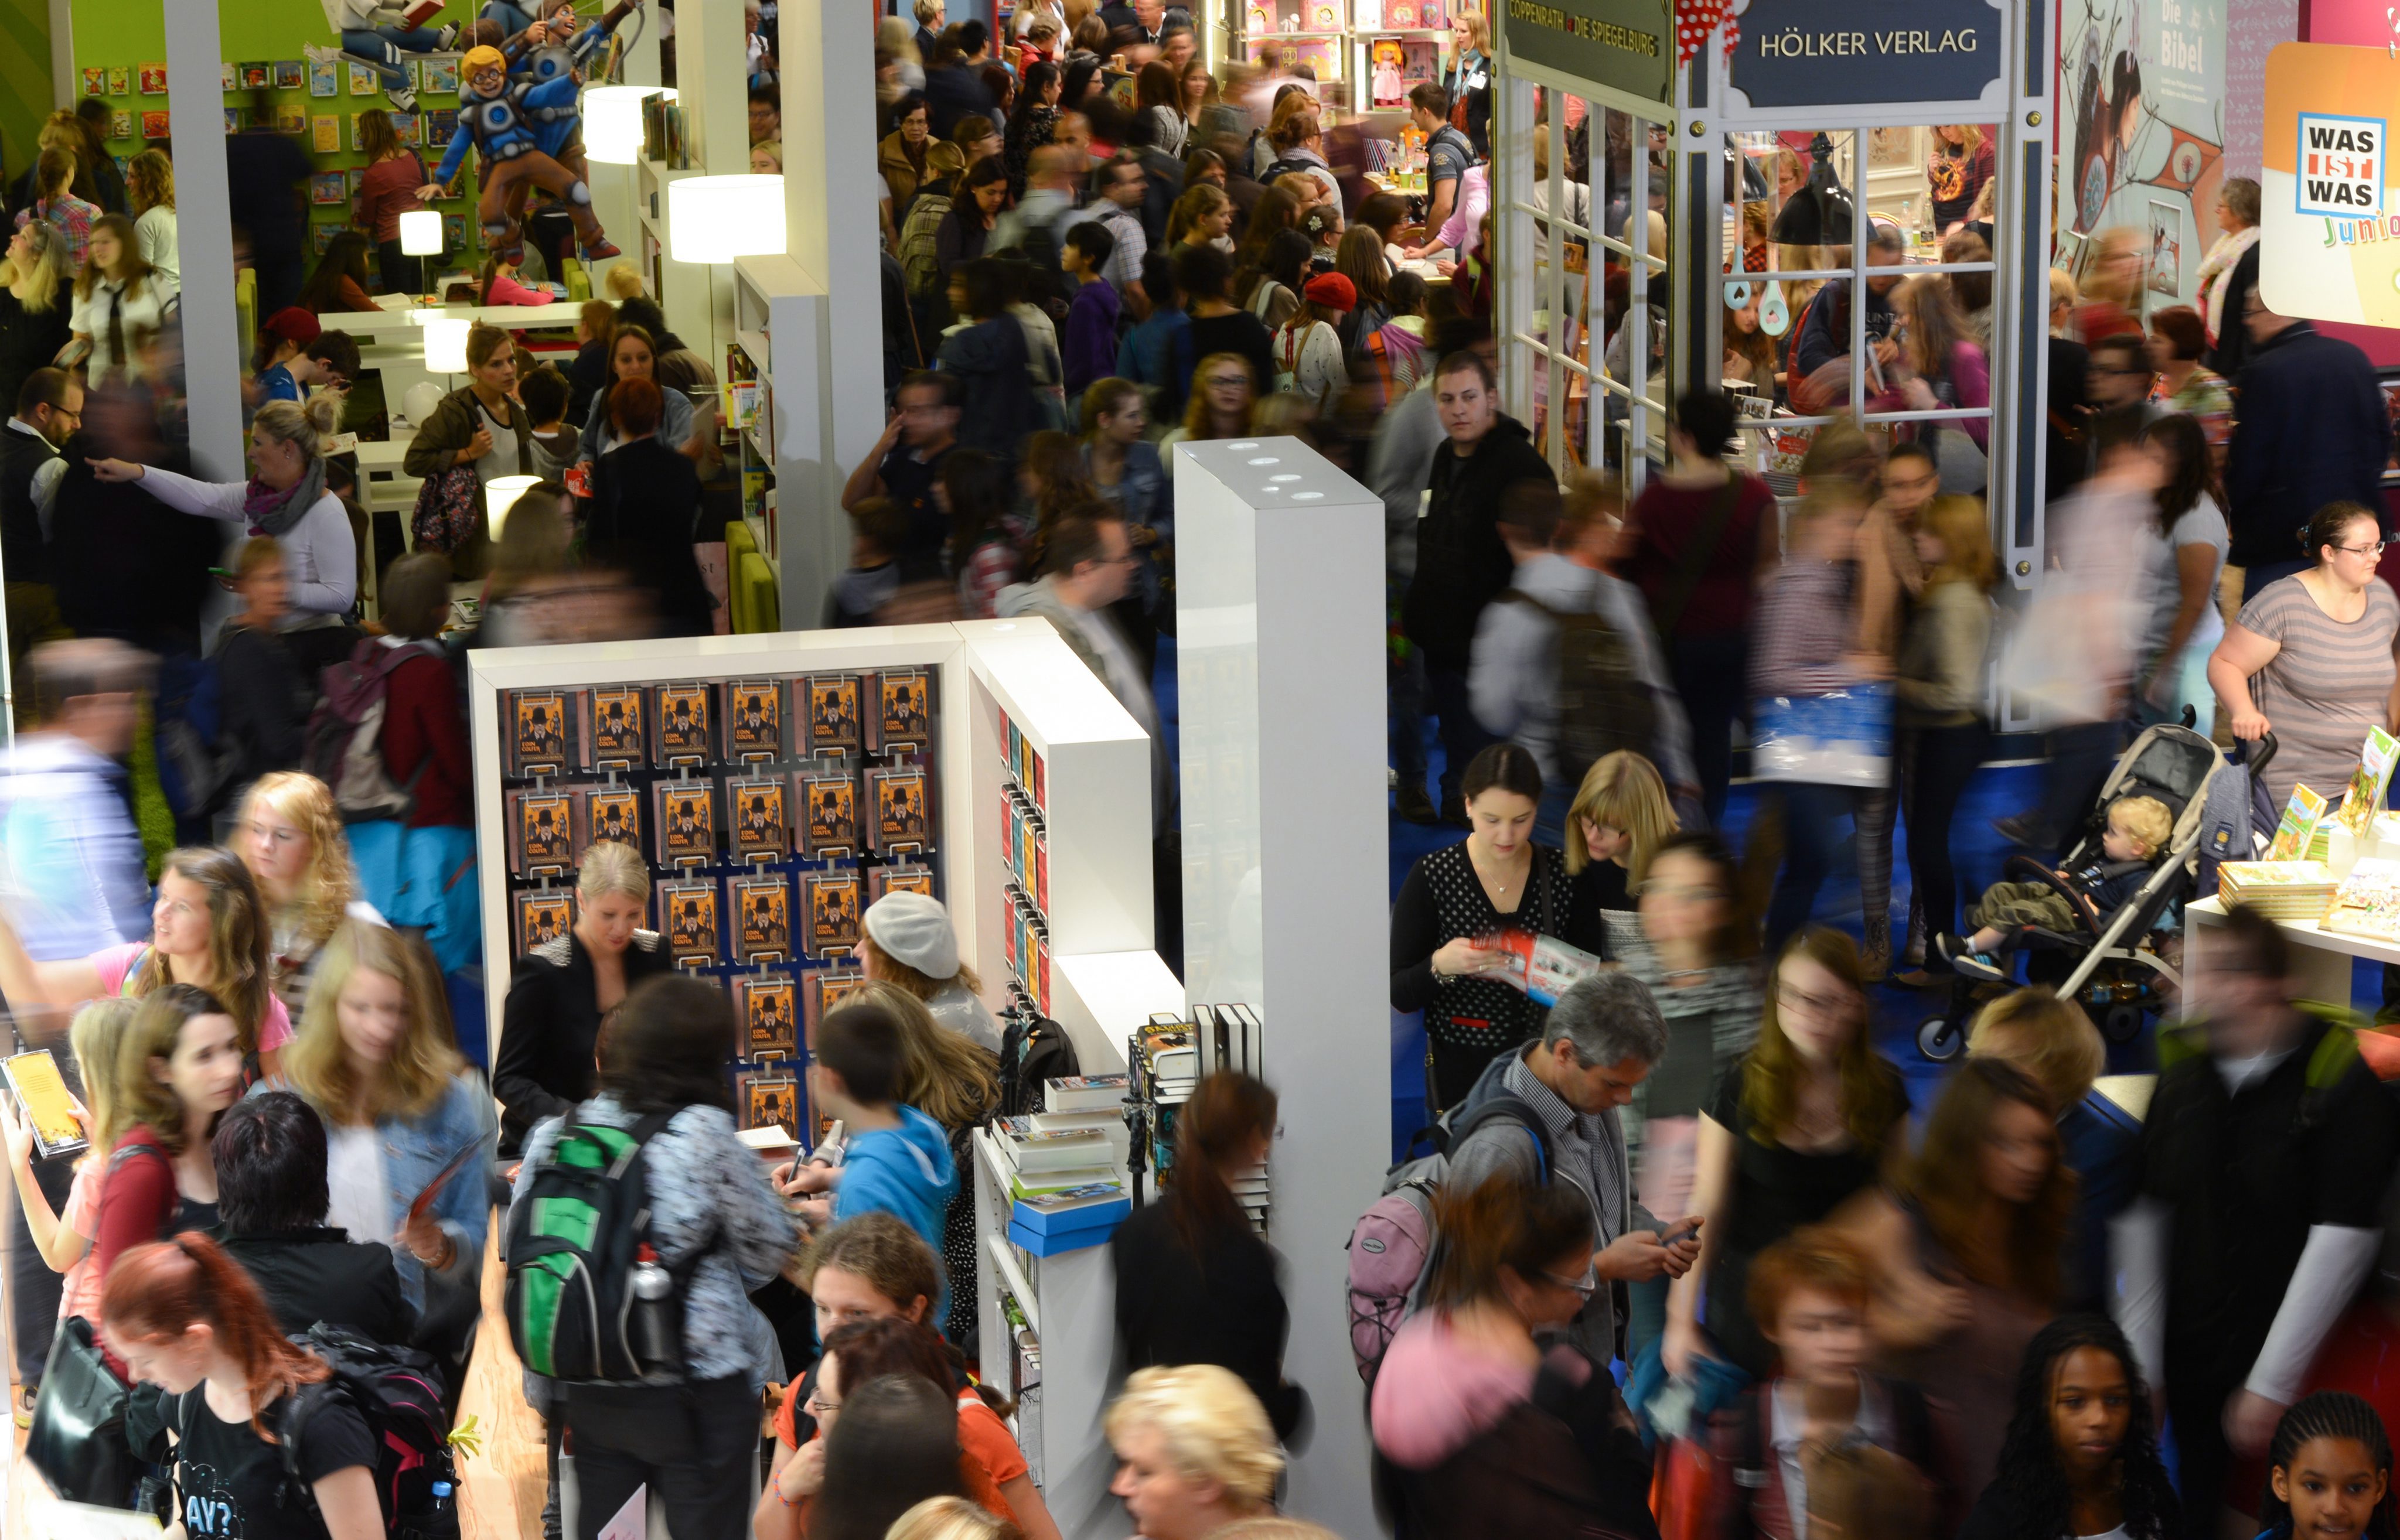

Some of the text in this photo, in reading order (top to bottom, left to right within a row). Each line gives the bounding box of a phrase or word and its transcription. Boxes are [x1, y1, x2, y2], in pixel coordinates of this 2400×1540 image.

[2162, 0, 2181, 25] Die
[1509, 0, 1656, 57] COPPENRATH DIE SPIEGELBURG
[1761, 26, 1977, 57] HÖLKER VERLAG
[2162, 30, 2203, 74] Bibel
[2309, 127, 2374, 153] WAS
[2308, 153, 2373, 180] IST
[2307, 179, 2372, 206] WAS
